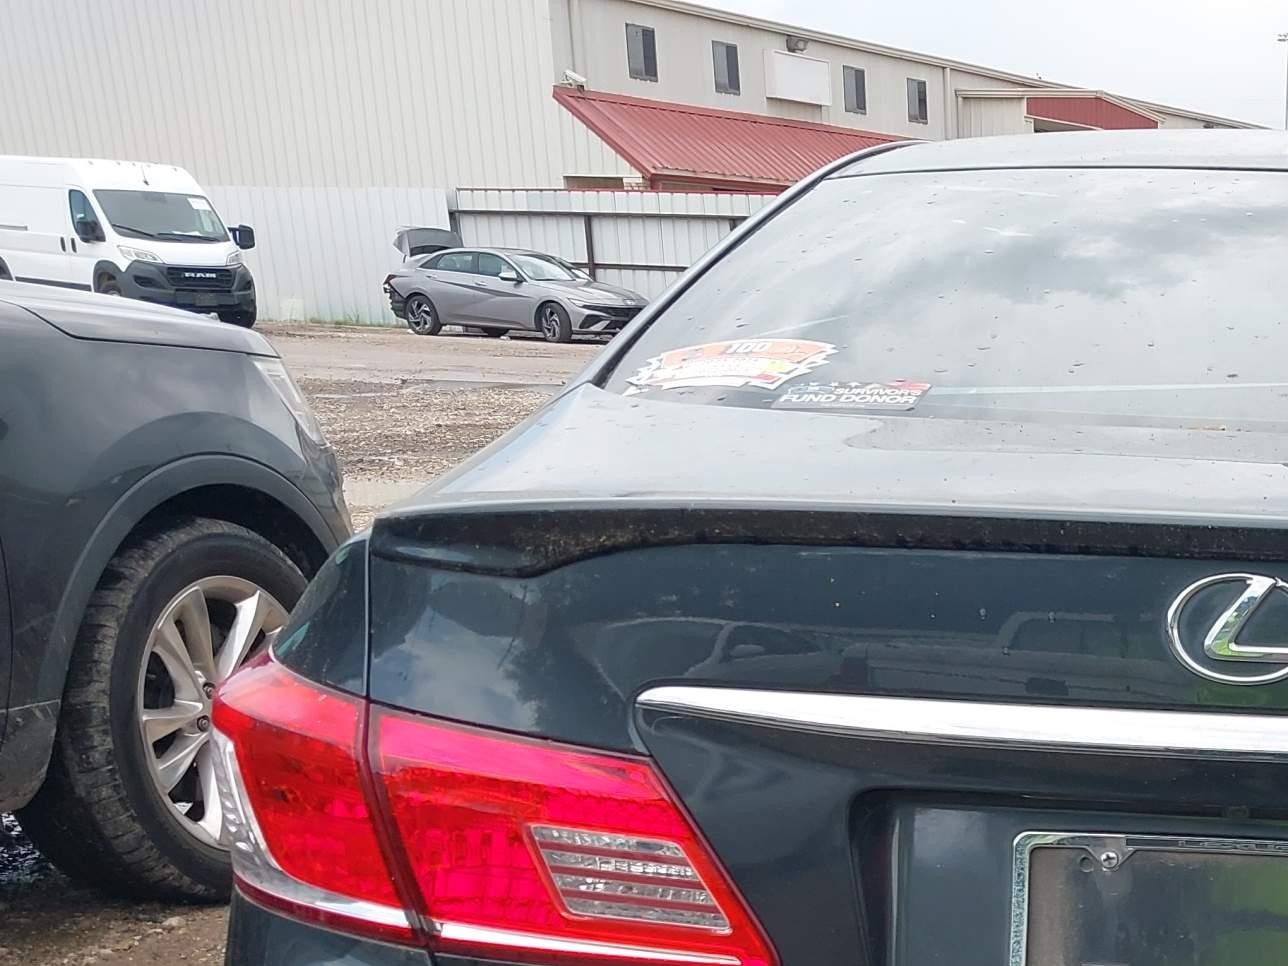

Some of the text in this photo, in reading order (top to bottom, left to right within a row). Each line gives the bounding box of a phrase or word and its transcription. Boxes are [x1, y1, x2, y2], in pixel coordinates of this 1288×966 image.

[833, 387, 922, 396] SURVIVORS
[780, 393, 918, 404] FUND DONOR
